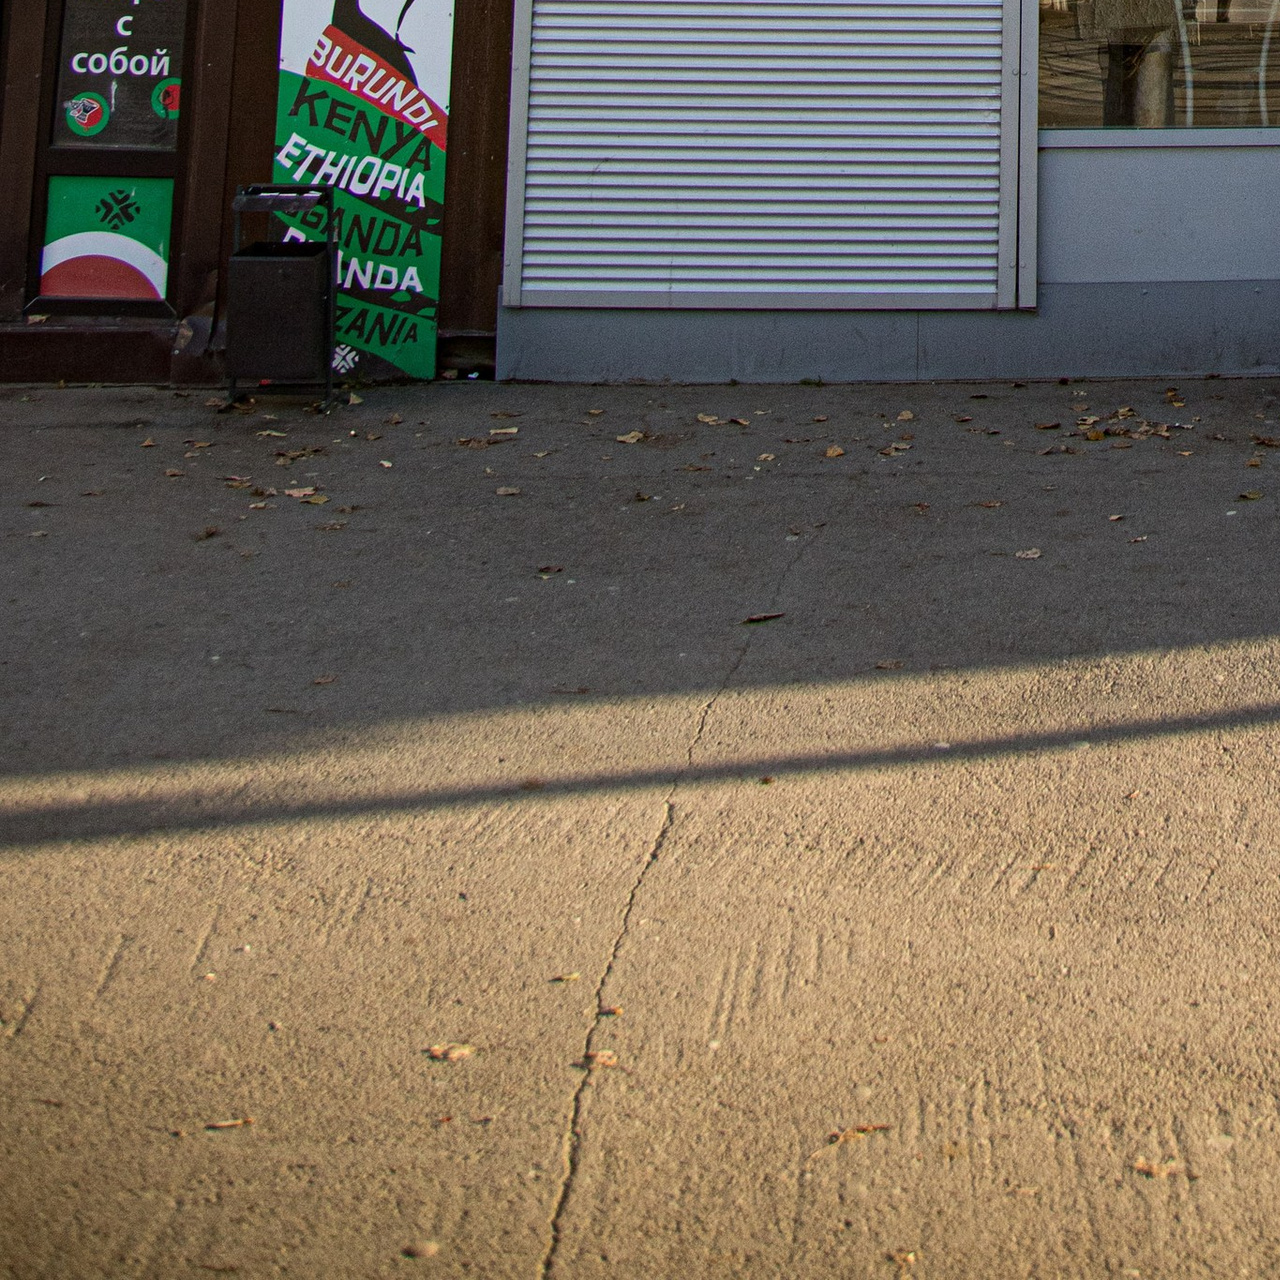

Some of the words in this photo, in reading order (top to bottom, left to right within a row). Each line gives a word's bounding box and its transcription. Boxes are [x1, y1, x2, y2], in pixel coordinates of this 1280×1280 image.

[115, 15, 134, 37] с
[70, 46, 171, 77] собой
[310, 34, 439, 132] BURUNDI
[288, 76, 433, 172] KENYA
[276, 131, 426, 208] ETHIOPIA
[333, 305, 419, 347] ZANIA
